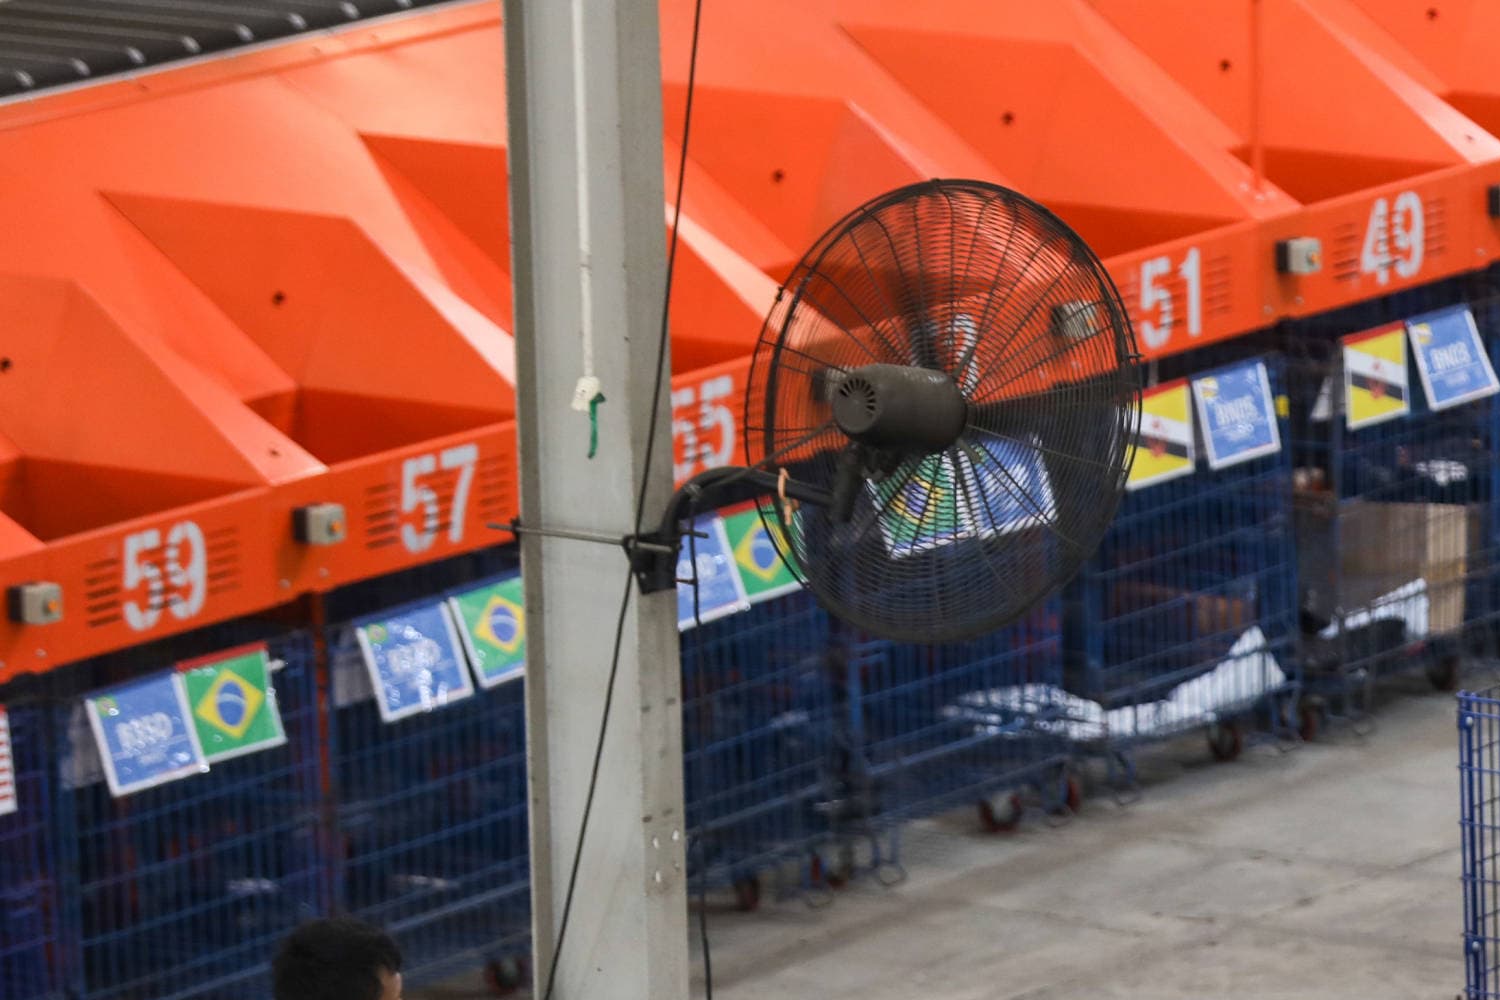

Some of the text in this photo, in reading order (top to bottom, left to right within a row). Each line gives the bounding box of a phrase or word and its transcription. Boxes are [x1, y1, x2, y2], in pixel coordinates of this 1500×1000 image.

[1361, 191, 1425, 285] 49
[1140, 247, 1201, 348] 51
[671, 375, 735, 482] 55
[401, 444, 479, 552] 57
[123, 521, 207, 631] 59
